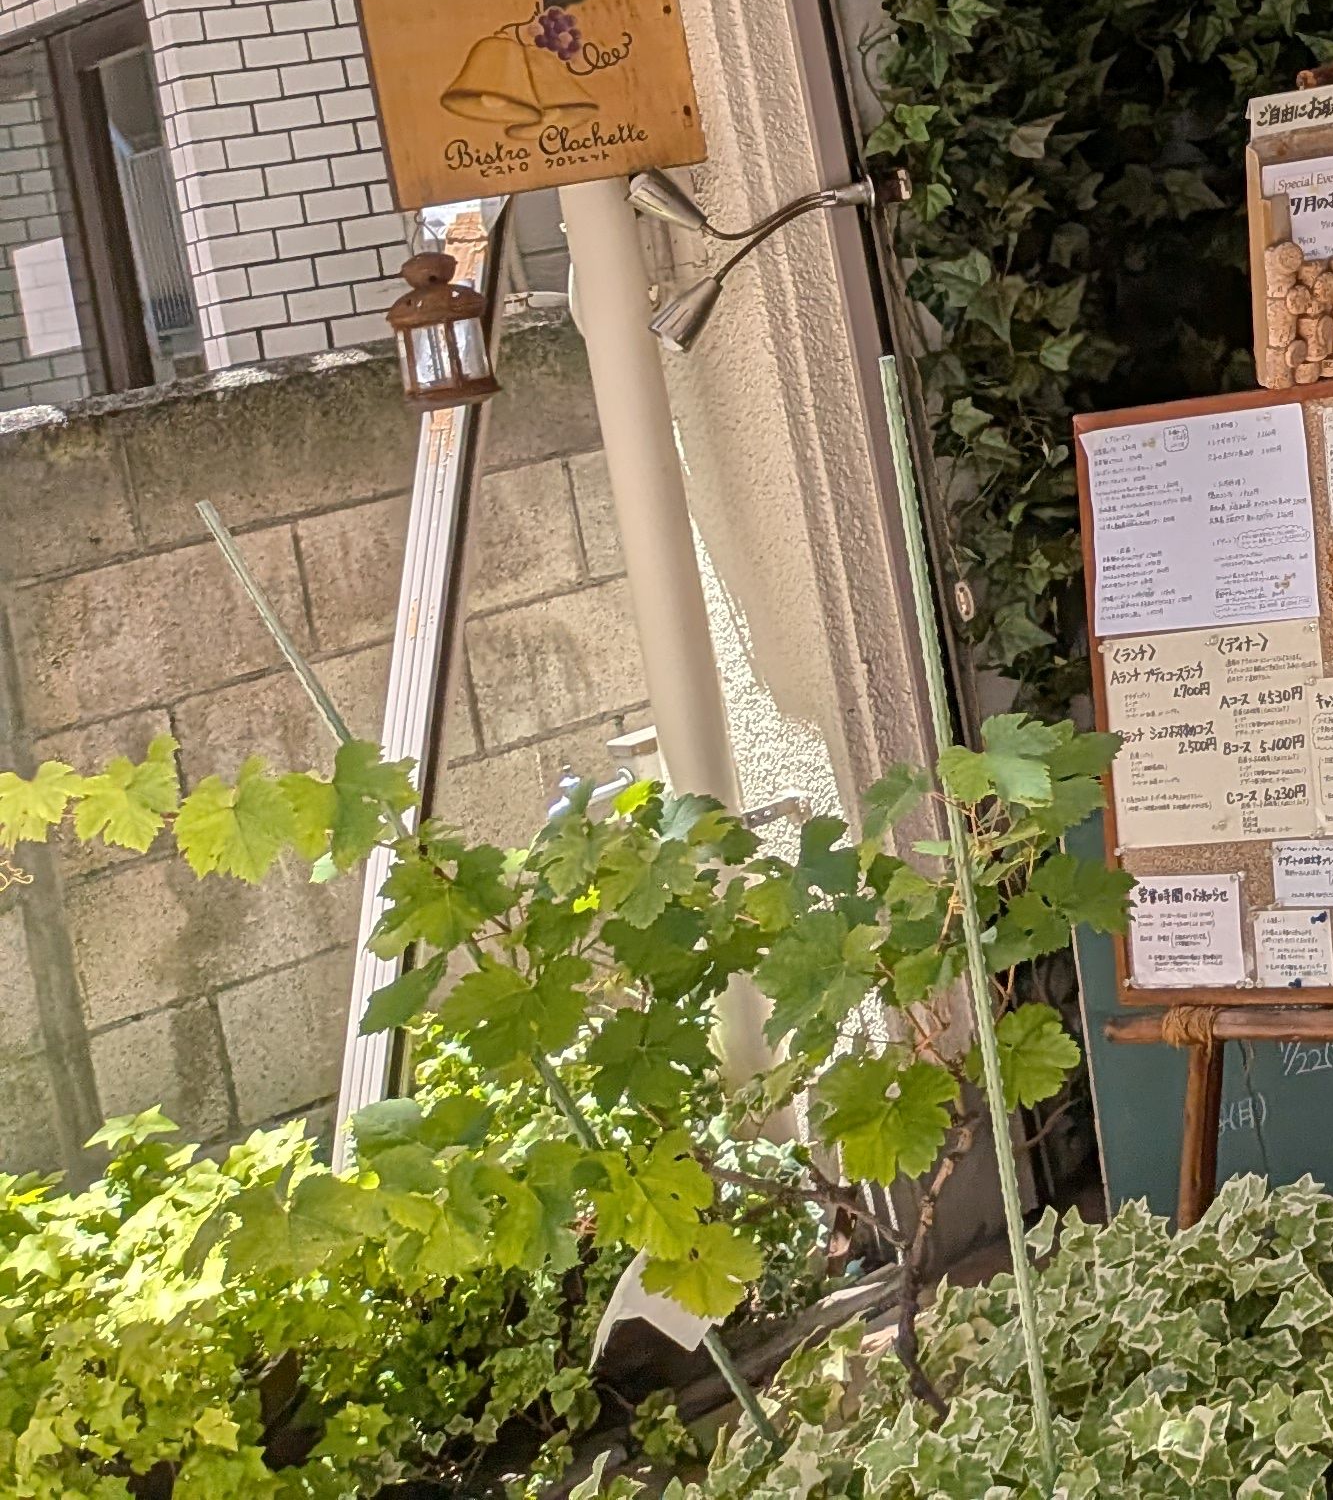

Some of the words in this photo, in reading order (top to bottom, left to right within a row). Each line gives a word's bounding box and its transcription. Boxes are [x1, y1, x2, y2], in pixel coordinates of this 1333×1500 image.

[480, 163, 529, 178] ビストロ
[1278, 172, 1314, 192] Special
[1219, 693, 1250, 710] Aコース
[1222, 741, 1252, 756] Bコース
[1226, 789, 1258, 805] Cコース
[1138, 885, 1229, 905] 営業時間のお知らせ
